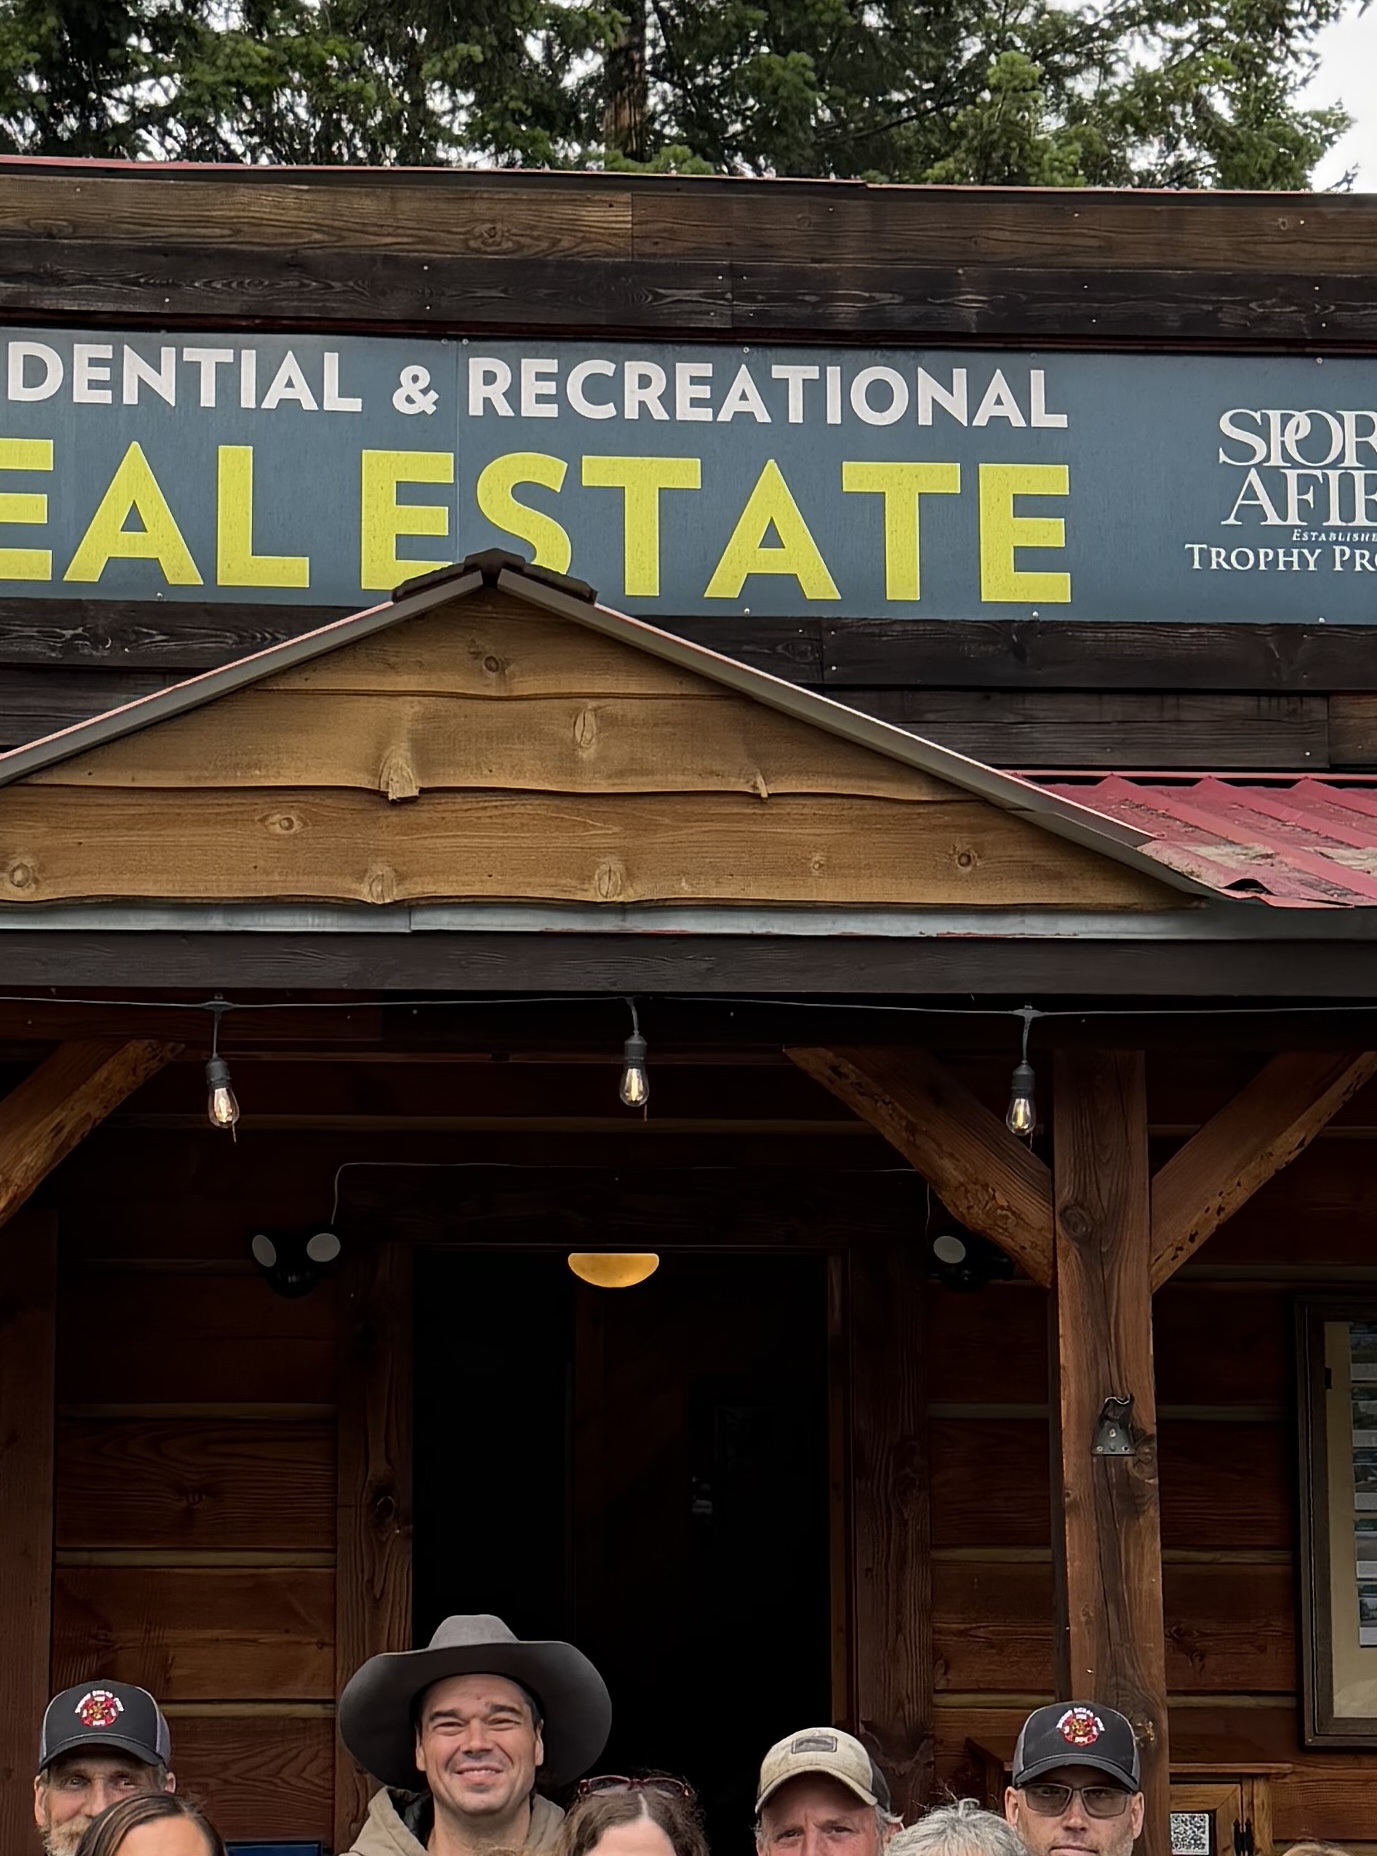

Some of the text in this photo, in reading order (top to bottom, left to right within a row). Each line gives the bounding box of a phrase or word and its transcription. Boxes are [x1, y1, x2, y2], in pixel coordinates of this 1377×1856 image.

[391, 364, 440, 415] &
[467, 356, 1069, 429] RECREATIONAL
[361, 448, 1072, 604] ESTATE
[1184, 543, 1323, 573] TROPHY
